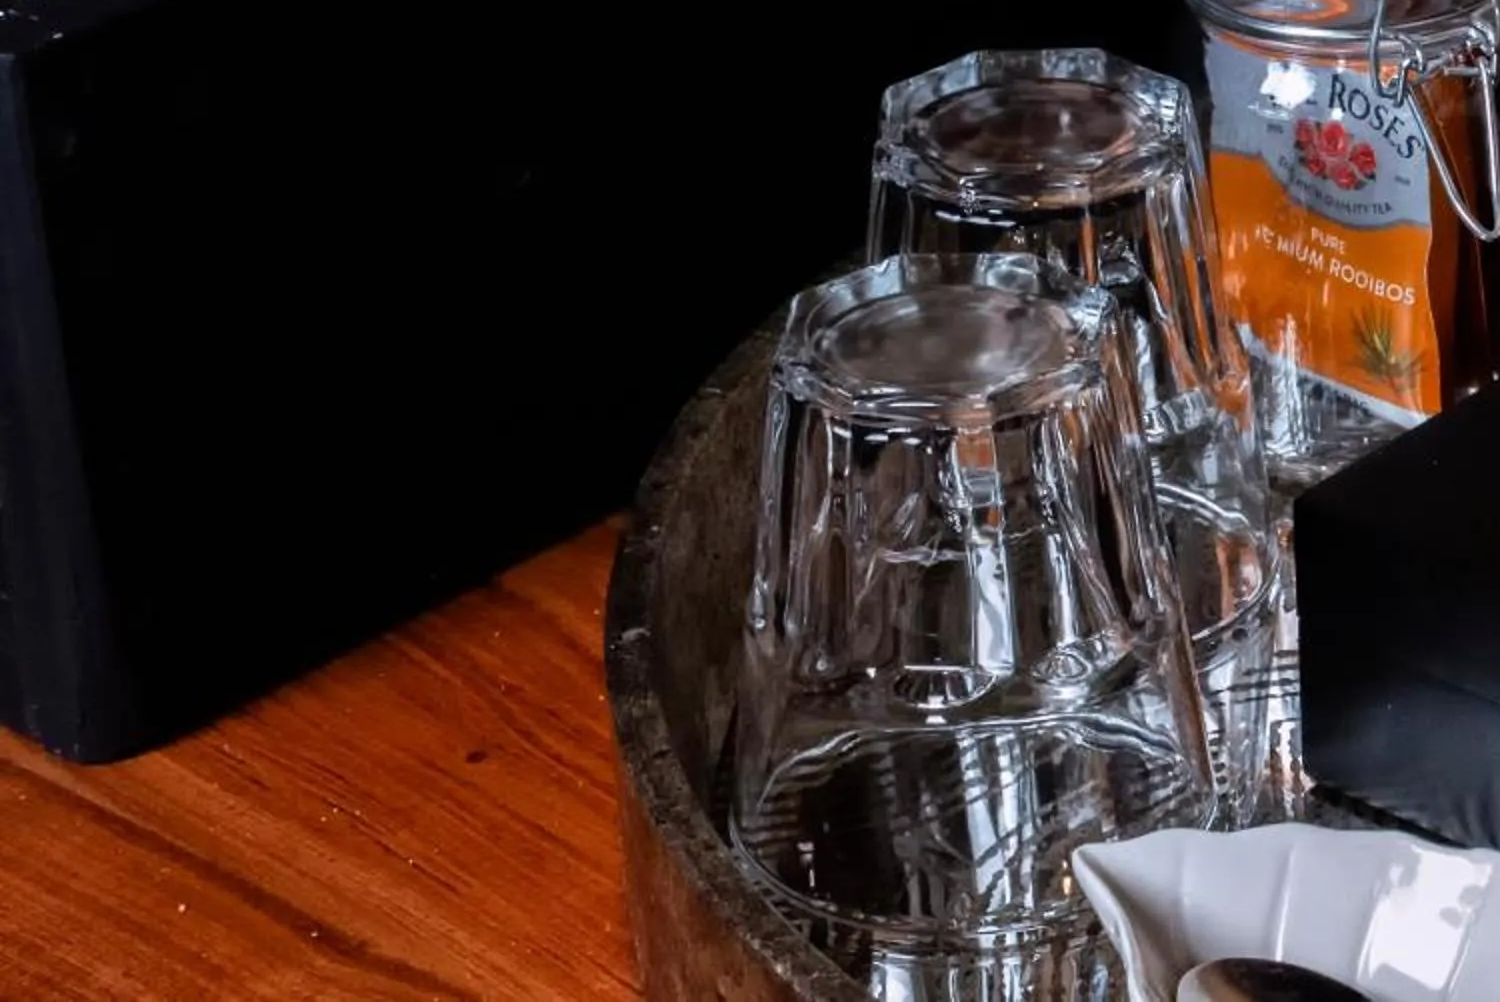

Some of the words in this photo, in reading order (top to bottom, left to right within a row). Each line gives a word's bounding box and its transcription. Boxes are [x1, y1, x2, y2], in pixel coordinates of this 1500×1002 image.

[1328, 73, 1422, 159] ROSES
[1311, 226, 1347, 255] PURE
[1330, 258, 1416, 306] ROOIBOS
